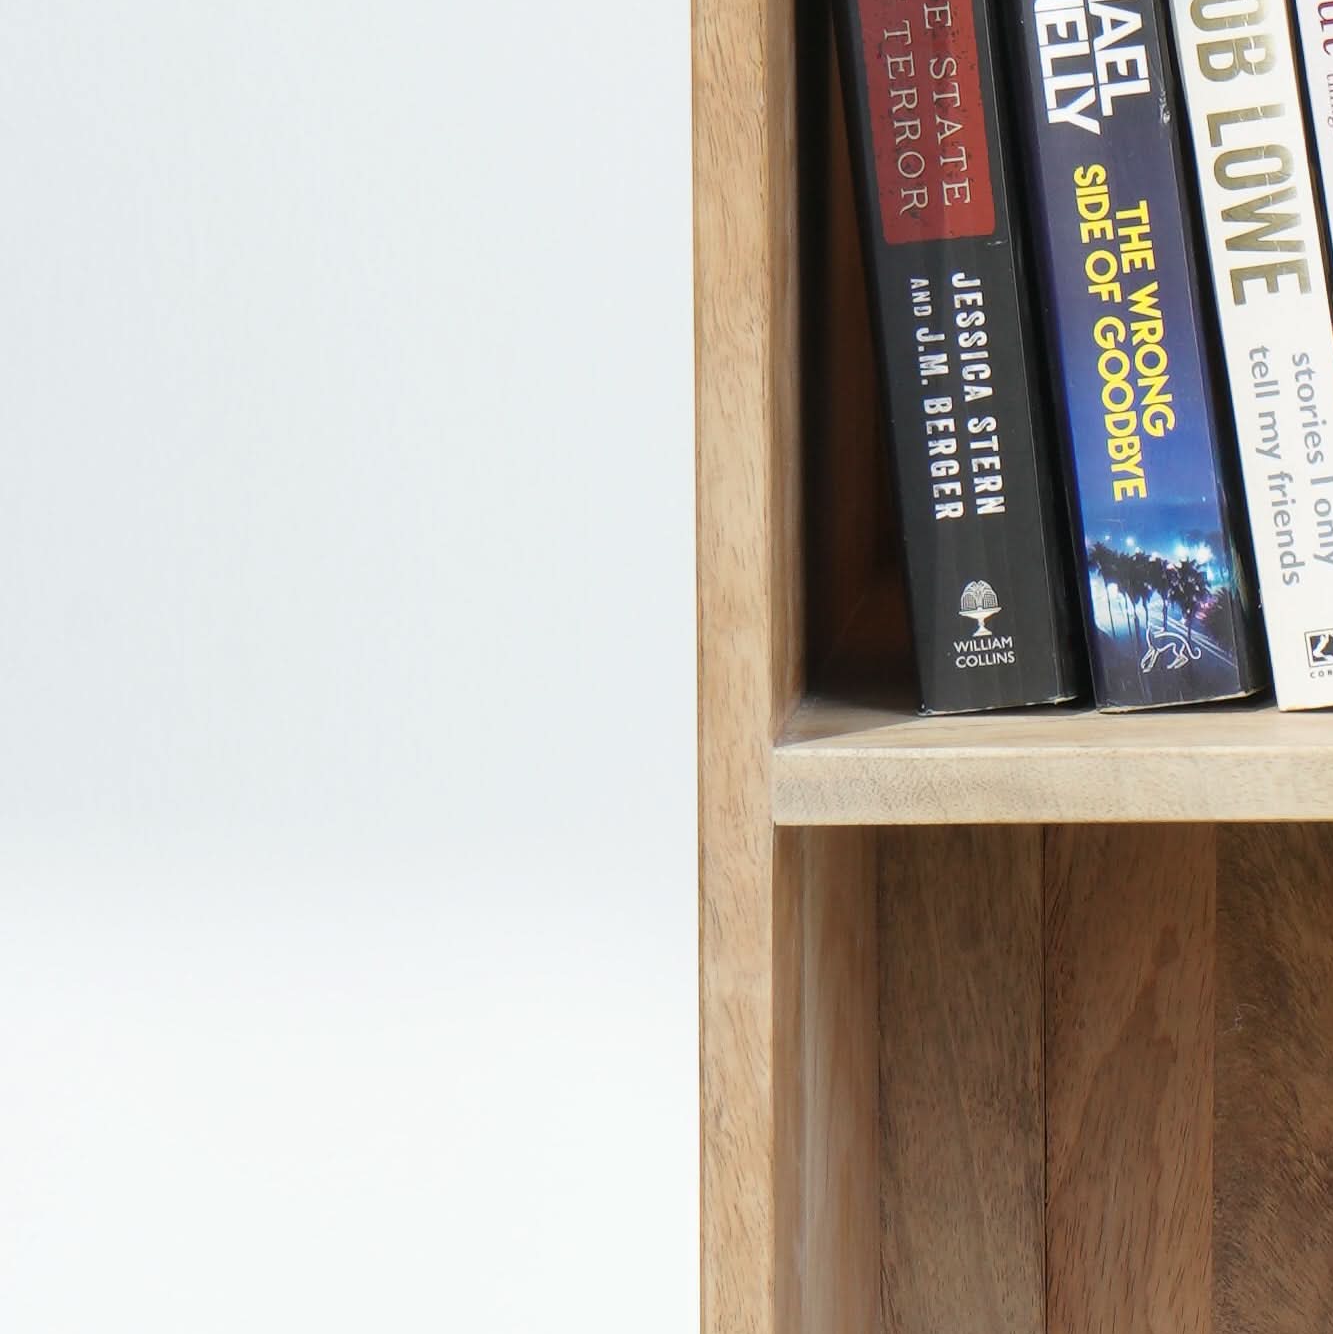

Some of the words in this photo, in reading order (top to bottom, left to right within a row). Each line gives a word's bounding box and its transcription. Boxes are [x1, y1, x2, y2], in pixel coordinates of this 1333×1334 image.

[884, 20, 929, 216] TERROR
[930, 57, 972, 207] STATE
[1073, 164, 1114, 244] SIDE
[1115, 200, 1156, 274] THE
[1206, 102, 1313, 307] LOWE
[910, 277, 933, 317] AND
[1085, 250, 1122, 304] OF
[916, 327, 949, 386] J.M.
[951, 271, 994, 403] JESSICA
[1128, 281, 1176, 438] WRONG
[1248, 345, 1281, 399] tell
[923, 396, 964, 520] BERGER
[1093, 316, 1148, 502] GOODBYE
[1255, 410, 1282, 460] my
[1291, 352, 1327, 465] stories
[967, 416, 1007, 515] STERN
[1267, 471, 1306, 587] friends
[953, 636, 1013, 653] WILLIAM
[955, 651, 1015, 668] COLLINS
